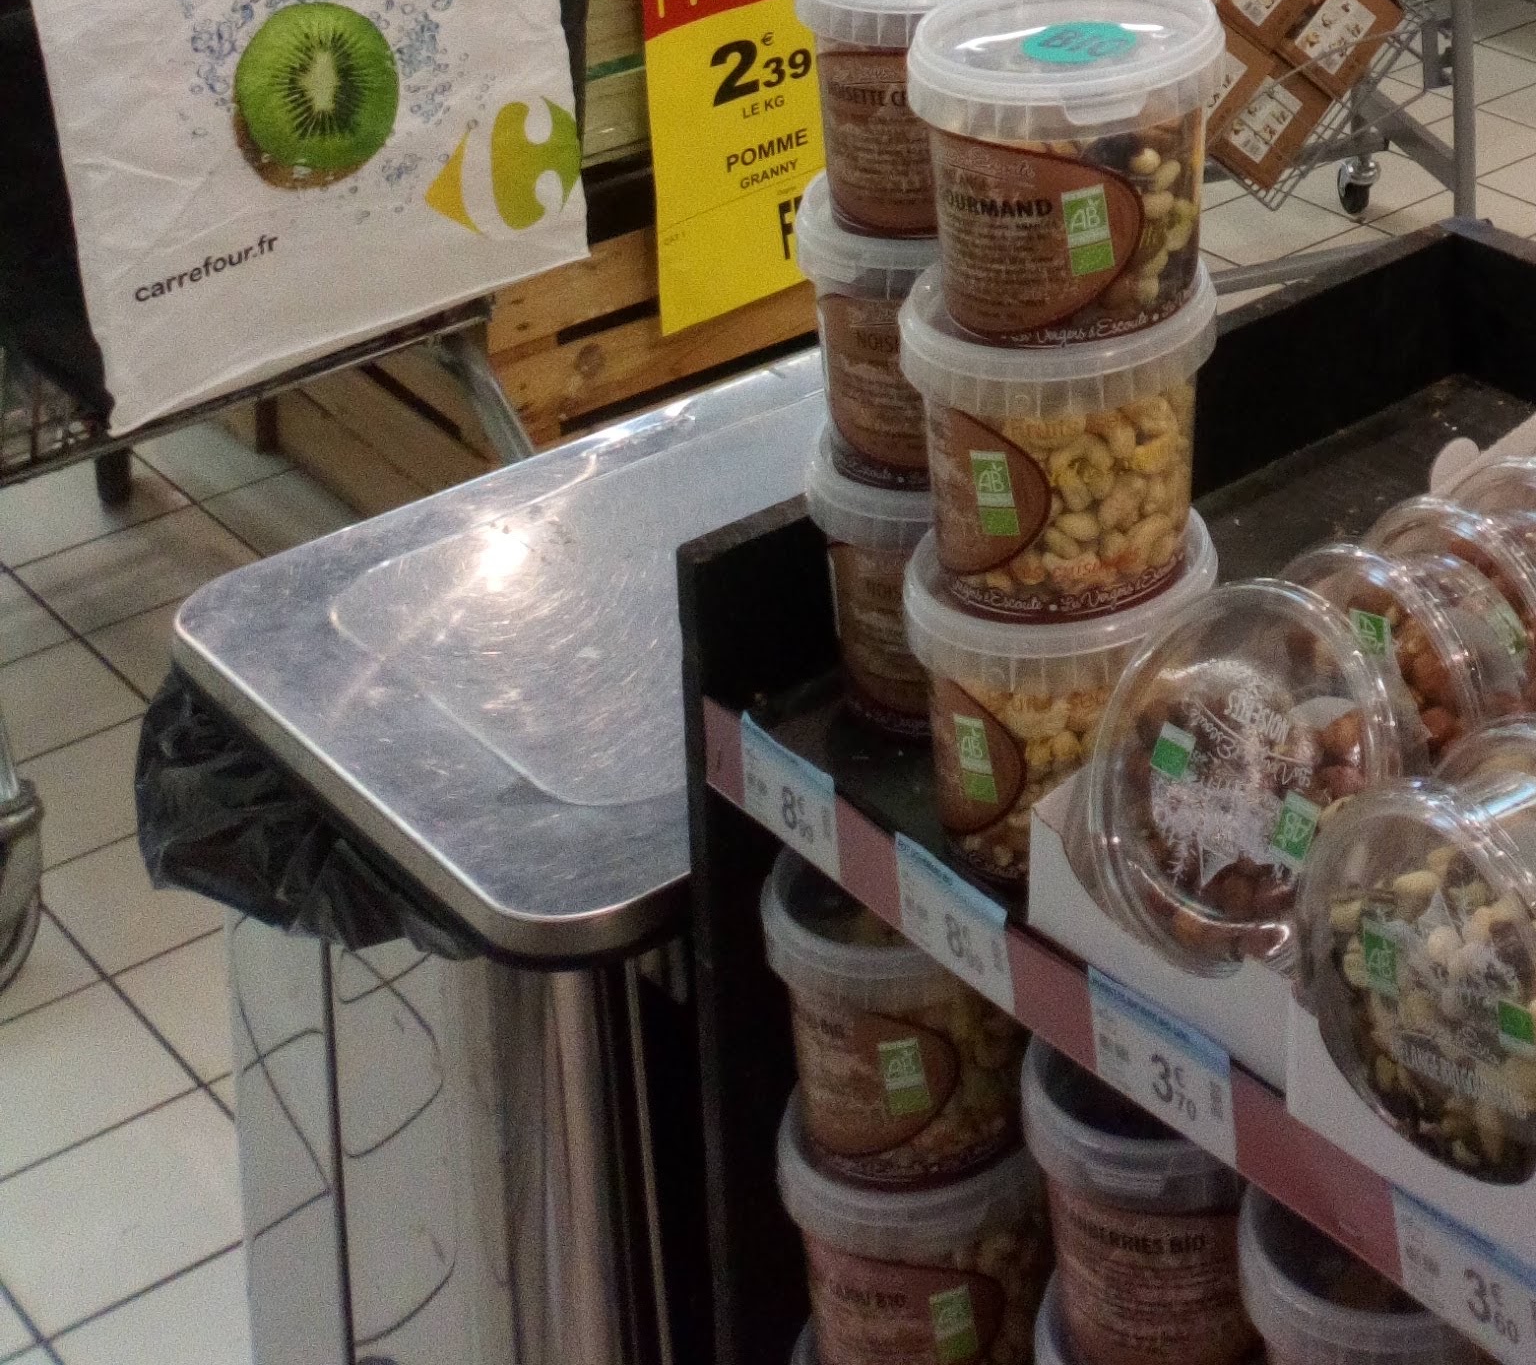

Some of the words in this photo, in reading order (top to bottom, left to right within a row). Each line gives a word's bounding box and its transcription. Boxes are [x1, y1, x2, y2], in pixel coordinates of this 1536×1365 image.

[1038, 27, 1129, 59] BIO
[742, 103, 761, 120] LE
[763, 94, 785, 113] KG
[725, 127, 809, 173] POMME
[739, 158, 799, 190] GRANNY
[133, 234, 279, 304] carrefour.fr
